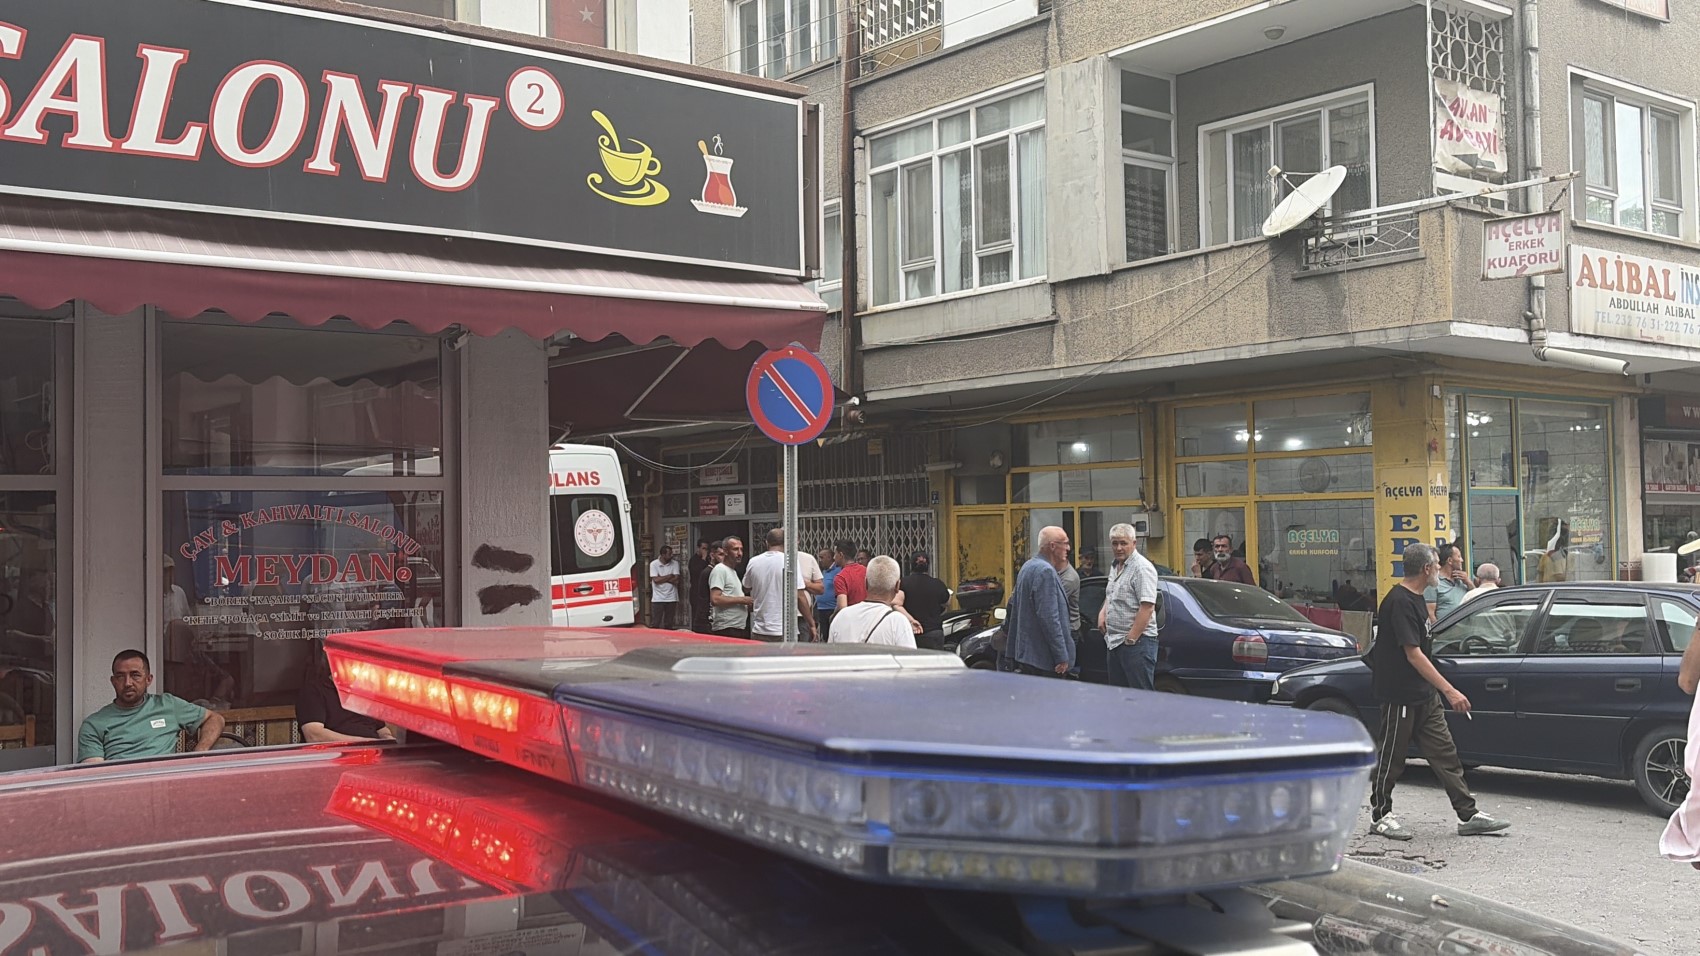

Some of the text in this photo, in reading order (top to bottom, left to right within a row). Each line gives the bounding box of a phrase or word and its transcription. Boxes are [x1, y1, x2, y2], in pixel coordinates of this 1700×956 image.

[526, 83, 545, 115] 2
[1488, 215, 1560, 242] AÇELYA
[1508, 238, 1545, 251] ERKEK
[1576, 254, 1676, 300] ALİBAL
[1609, 297, 1659, 314] ABDULLAH
[1385, 486, 1423, 500] AÇELYA
[180, 526, 217, 561] ÇAY
[222, 520, 239, 537] &
[240, 504, 345, 529] KAHVALTI
[346, 511, 421, 555] SALONU
[1288, 530, 1339, 548] AÇELYA
[214, 552, 397, 587] MEYDAN
[605, 580, 618, 590] 112
[263, 628, 300, 640] SOĞUK
